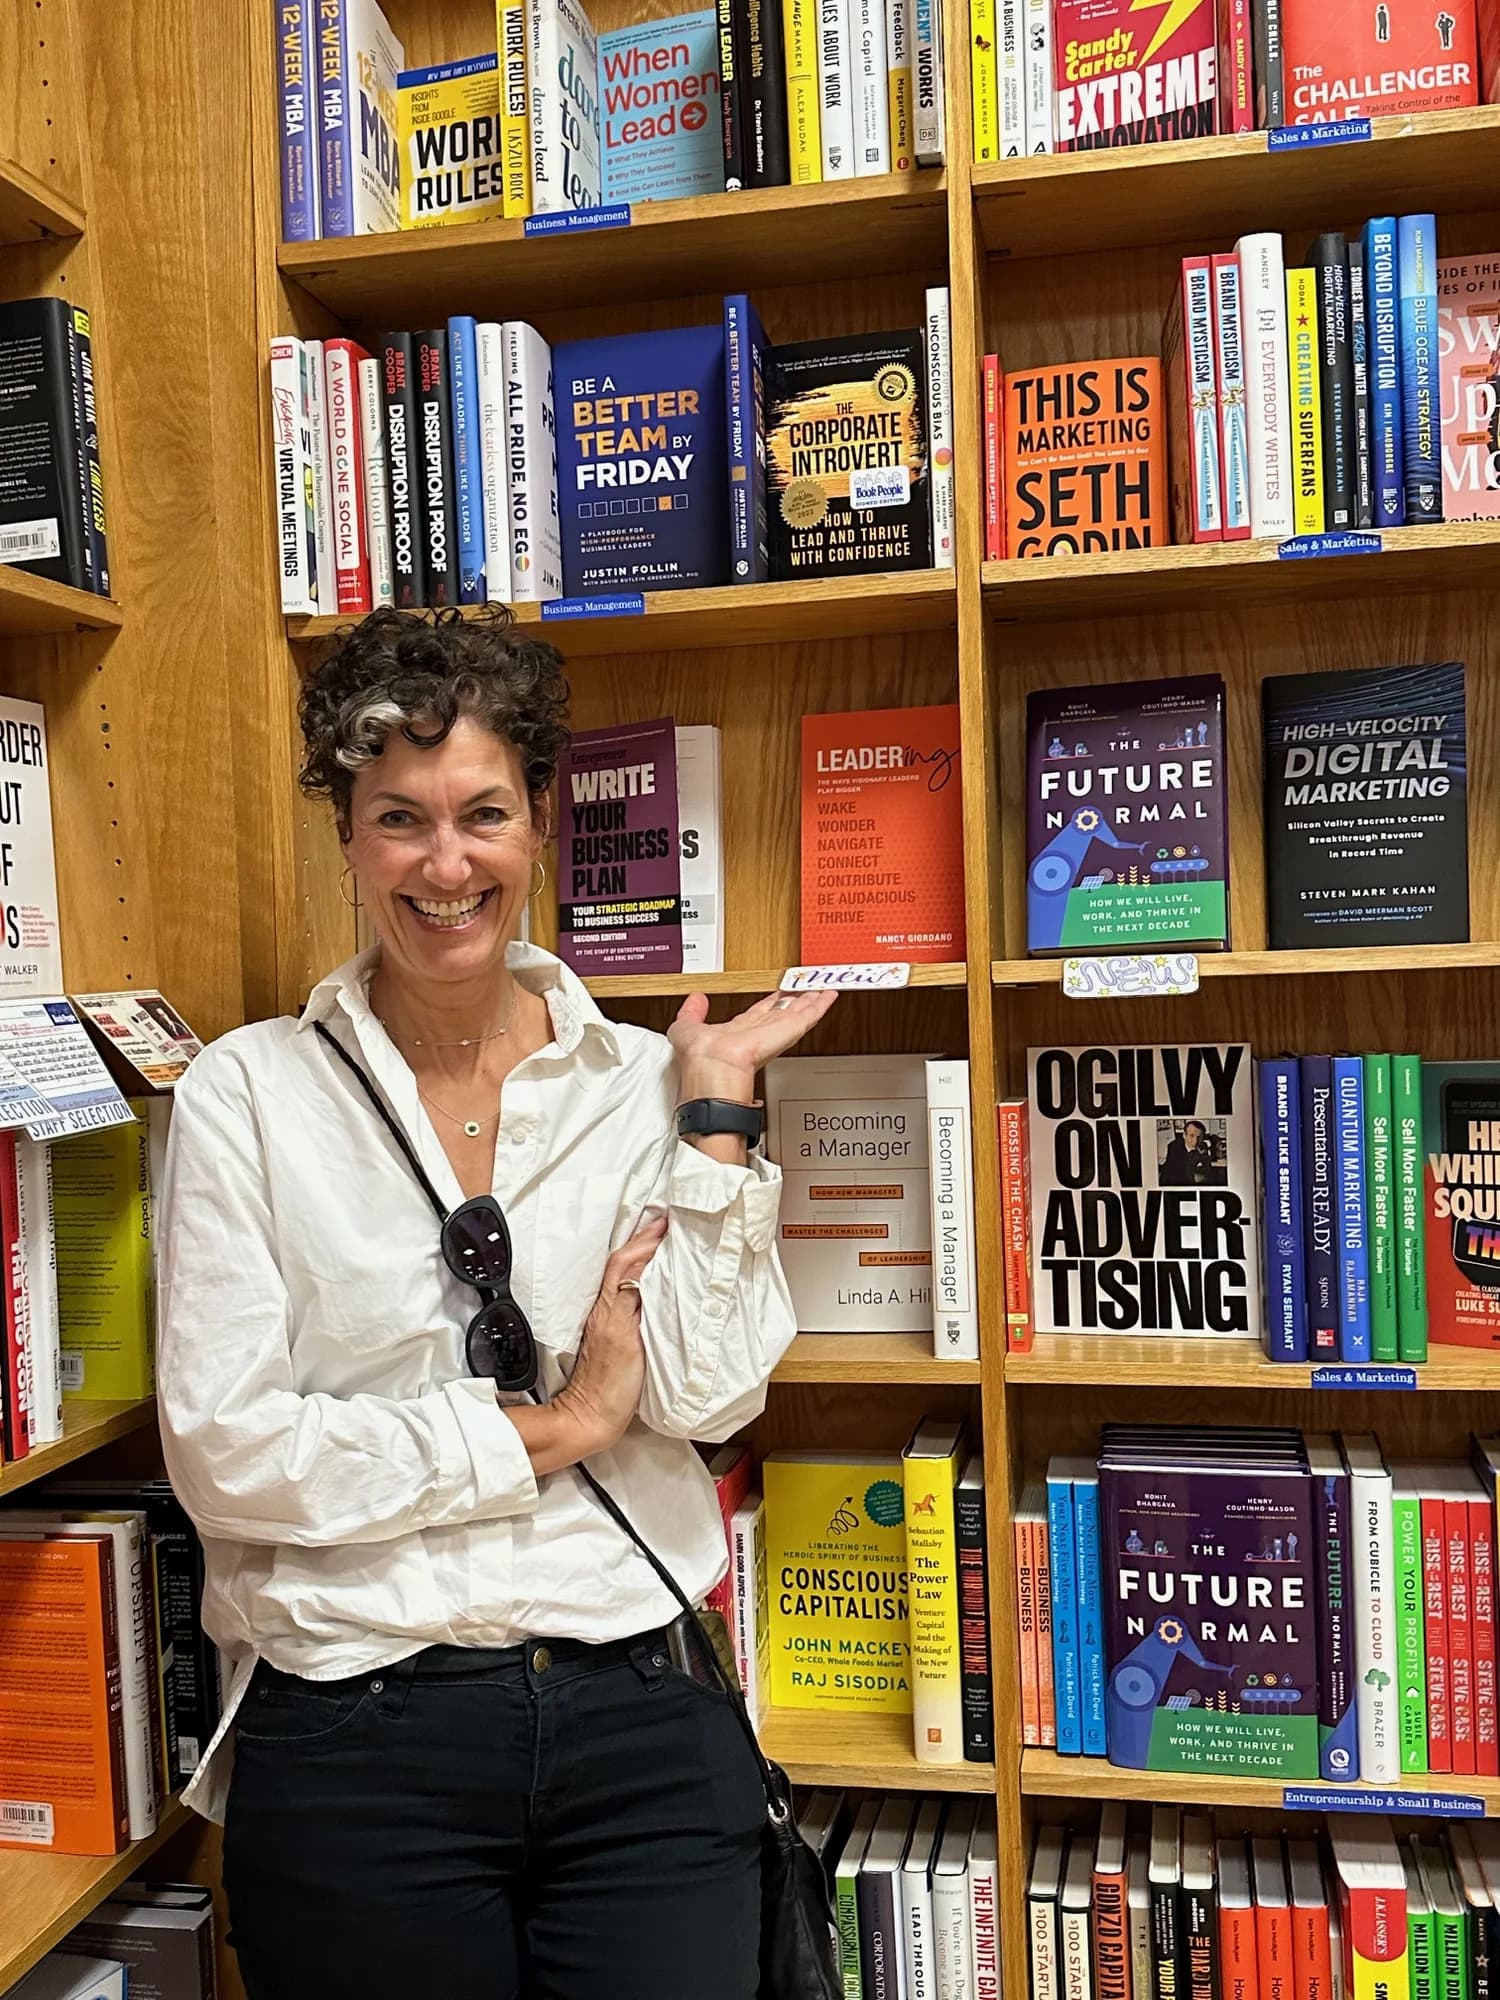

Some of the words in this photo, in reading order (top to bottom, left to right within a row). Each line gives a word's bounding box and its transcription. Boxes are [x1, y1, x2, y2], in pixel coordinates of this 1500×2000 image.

[282, 2, 303, 87] 12-WEEK
[506, 9, 524, 58] WORK
[893, 3, 903, 60] Feedback
[1065, 28, 1134, 62] Sandy
[604, 44, 690, 82] When
[1065, 50, 1138, 81] Carter
[1293, 65, 1323, 80] The
[411, 89, 439, 102] INSIGHTS
[508, 60, 526, 118] RULES!
[605, 72, 719, 114] Women
[1056, 46, 1216, 142] EXTREME
[1293, 63, 1471, 108] CHALLENGER
[285, 94, 305, 137] MBA
[411, 103, 429, 114] FROM
[411, 113, 431, 125] INSIDE
[432, 108, 456, 121] GOOGLE
[533, 87, 545, 127] dare
[507, 128, 523, 166] LASZLO
[533, 129, 545, 144] to
[605, 111, 675, 148] Lead
[1270, 132, 1298, 145] Sales
[1301, 131, 1309, 140] &
[1312, 124, 1369, 138] Marketing
[535, 145, 549, 183] lead
[510, 168, 524, 200] BOCK
[525, 215, 567, 231] Business
[569, 207, 628, 227] Management
[1374, 234, 1392, 294] BEYOND
[1191, 275, 1205, 313] BRAND
[1415, 299, 1426, 335] BLUE
[929, 315, 941, 408] UNCONSCIOUS
[1193, 316, 1210, 383] MYSTICISM
[1377, 298, 1396, 390] DISRUPTION
[1415, 337, 1429, 384] OCEAN
[385, 347, 395, 395] COOPER
[395, 352, 406, 388] BRANT
[572, 378, 596, 395] BE
[602, 376, 615, 392] A
[1262, 340, 1278, 434] EVERYBODY
[1297, 333, 1313, 406] CREATING
[508, 380, 523, 419] ALL
[573, 390, 700, 428] BETTER
[835, 402, 853, 414] THE
[1012, 371, 1100, 425] THIS
[1115, 368, 1150, 413] IS
[575, 425, 667, 458] TEAM
[672, 435, 693, 448] BY
[789, 412, 901, 448] CORPORATE
[932, 412, 943, 439] BIAS
[1017, 417, 1150, 455] MARKETING
[1416, 388, 1432, 460] STRATEGY
[389, 404, 408, 511] DISRUPTION
[510, 423, 525, 488] PRIDE,
[576, 454, 694, 491] FRIDAY
[792, 441, 903, 477] INTROVERT
[1266, 438, 1280, 501] WRITES
[1299, 410, 1316, 497] SUPERFANS
[280, 448, 294, 509] VIRTUAL
[856, 487, 877, 498] Book
[877, 484, 903, 498] People
[1016, 460, 1150, 531] SETH
[513, 493, 527, 522] NO
[824, 514, 852, 528] HOW
[859, 510, 874, 523] TO
[281, 511, 298, 577] MEETINGS
[394, 512, 412, 574] PROOF
[791, 550, 823, 566] WITH
[829, 542, 911, 562] CONFIDENCE
[792, 530, 824, 548] LEAD
[829, 529, 855, 544] AND
[861, 525, 909, 540] THRIVE
[583, 565, 629, 579] JUSTIN
[632, 562, 678, 575] FOLLIN
[543, 602, 583, 614] Business
[585, 599, 642, 613] Management
[1109, 740, 1141, 751] THE
[1283, 715, 1448, 742] HIGH-VELOCITY
[1284, 738, 1449, 779] DIGITAL
[570, 763, 656, 803] WRITE
[1040, 759, 1214, 800] FUTURE
[1284, 776, 1450, 806] MARKETING
[571, 801, 627, 834] YOUR
[817, 801, 857, 815] WAKE
[817, 819, 876, 833] WONDER
[572, 827, 669, 867] BUSINESS
[817, 837, 884, 851] NAVIGATE
[817, 855, 880, 869] CONNECT
[572, 865, 627, 897] PLAN
[817, 873, 902, 888] CONTRIBUTE
[817, 894, 834, 905] BE
[839, 890, 916, 905] AUDACIOUS
[1300, 889, 1346, 899] STEVEN
[1352, 888, 1386, 897] MARK
[1393, 885, 1436, 895] KAHAN
[817, 911, 865, 924] THRIVE
[876, 935, 904, 943] NANCY
[908, 933, 952, 943] GIORDANO
[5, 966, 38, 975] WALKER
[1036, 1046, 1244, 1119] OGILVY
[1277, 1076, 1288, 1120] BRAND
[32, 1118, 66, 1137] STAFF
[72, 1102, 132, 1129] SELECTION
[804, 1113, 906, 1134] Becoming
[1278, 1123, 1288, 1133] IT
[1340, 1077, 1359, 1153] QUANTUM
[1374, 1117, 1387, 1143] Sell
[800, 1143, 811, 1157] a
[819, 1139, 911, 1160] Manager
[1007, 1112, 1020, 1175] CROSSING
[1055, 1119, 1143, 1189] ON
[1278, 1136, 1289, 1164] LIKE
[1313, 1087, 1329, 1184] Presentation
[938, 1116, 956, 1205] Becoming
[1375, 1146, 1388, 1182] More
[1010, 1179, 1021, 1202] THE
[1279, 1167, 1291, 1224] SERHANT
[1343, 1157, 1361, 1249] MARKETING
[1376, 1185, 1388, 1229] Faster
[942, 1210, 954, 1220] a
[1011, 1208, 1023, 1252] CHASM
[1041, 1189, 1251, 1260] ADVER-
[1313, 1186, 1330, 1255] READY
[941, 1226, 958, 1305] Manager
[1041, 1259, 1248, 1332] TISING
[1367, 1501, 1379, 1537] FROM
[1401, 1510, 1414, 1565] POWER
[915, 1557, 940, 1569] The
[1192, 1545, 1225, 1557] THE
[1368, 1540, 1381, 1593] CUBICLE
[781, 1567, 909, 1594] CONSCIOUS
[909, 1572, 948, 1585] Power
[916, 1588, 942, 1600] Law
[1119, 1569, 1305, 1609] FUTURE
[1403, 1569, 1415, 1612] YOUR
[1020, 1568, 1031, 1633] BUSINESS
[1371, 1597, 1381, 1614] TO
[1372, 1618, 1382, 1660] CLOUD
[1405, 1617, 1418, 1679] PROFITS
[792, 1671, 827, 1687] RAJ
[835, 1674, 909, 1691] SISODIA
[1374, 1701, 1384, 1749] BRAZER
[1286, 1792, 1383, 1807] Entrepreneurship
[1386, 1797, 1394, 1806] &
[1397, 1797, 1429, 1808] Small
[1433, 1799, 1482, 1810] Business
[974, 1877, 992, 1906] THE
[1096, 1883, 1121, 1938] GONZO
[975, 1908, 996, 1971] INFINITE
